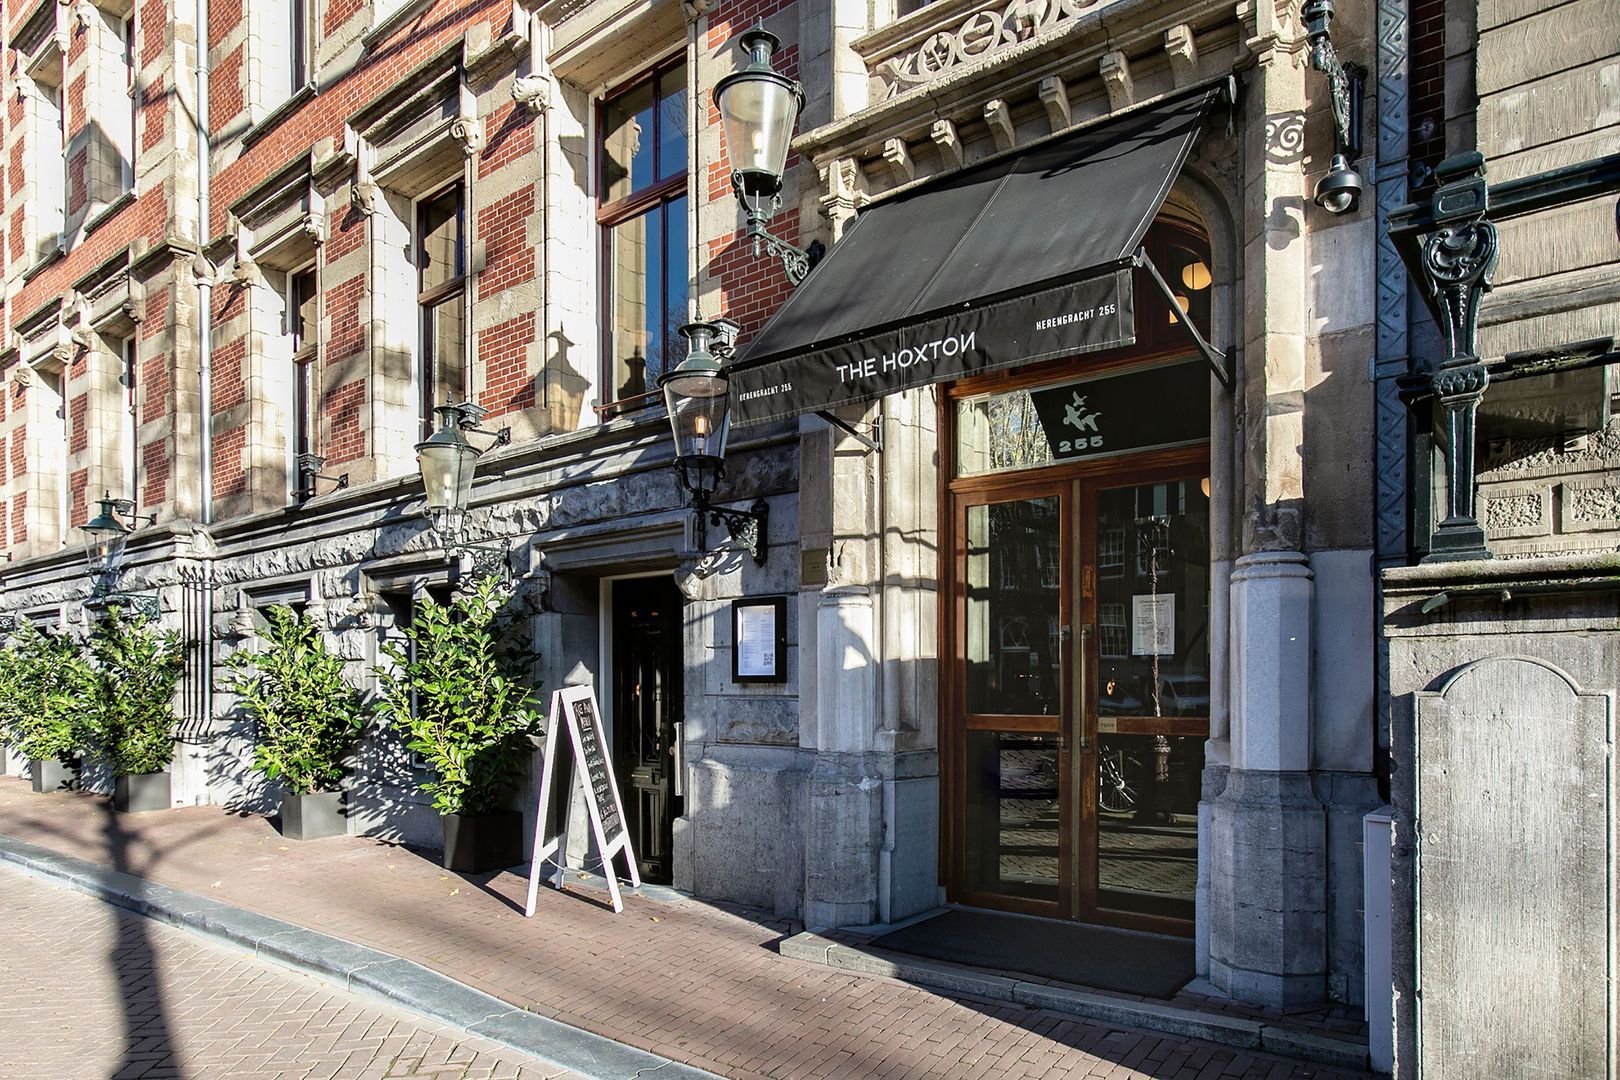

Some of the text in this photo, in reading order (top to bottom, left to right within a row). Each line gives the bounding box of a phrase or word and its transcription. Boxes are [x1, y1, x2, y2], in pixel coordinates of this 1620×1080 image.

[1036, 304, 1116, 331] HERENGRACHT 255
[836, 331, 975, 383] THE HOXTON
[781, 382, 792, 393] 255
[1059, 435, 1104, 453] 255
